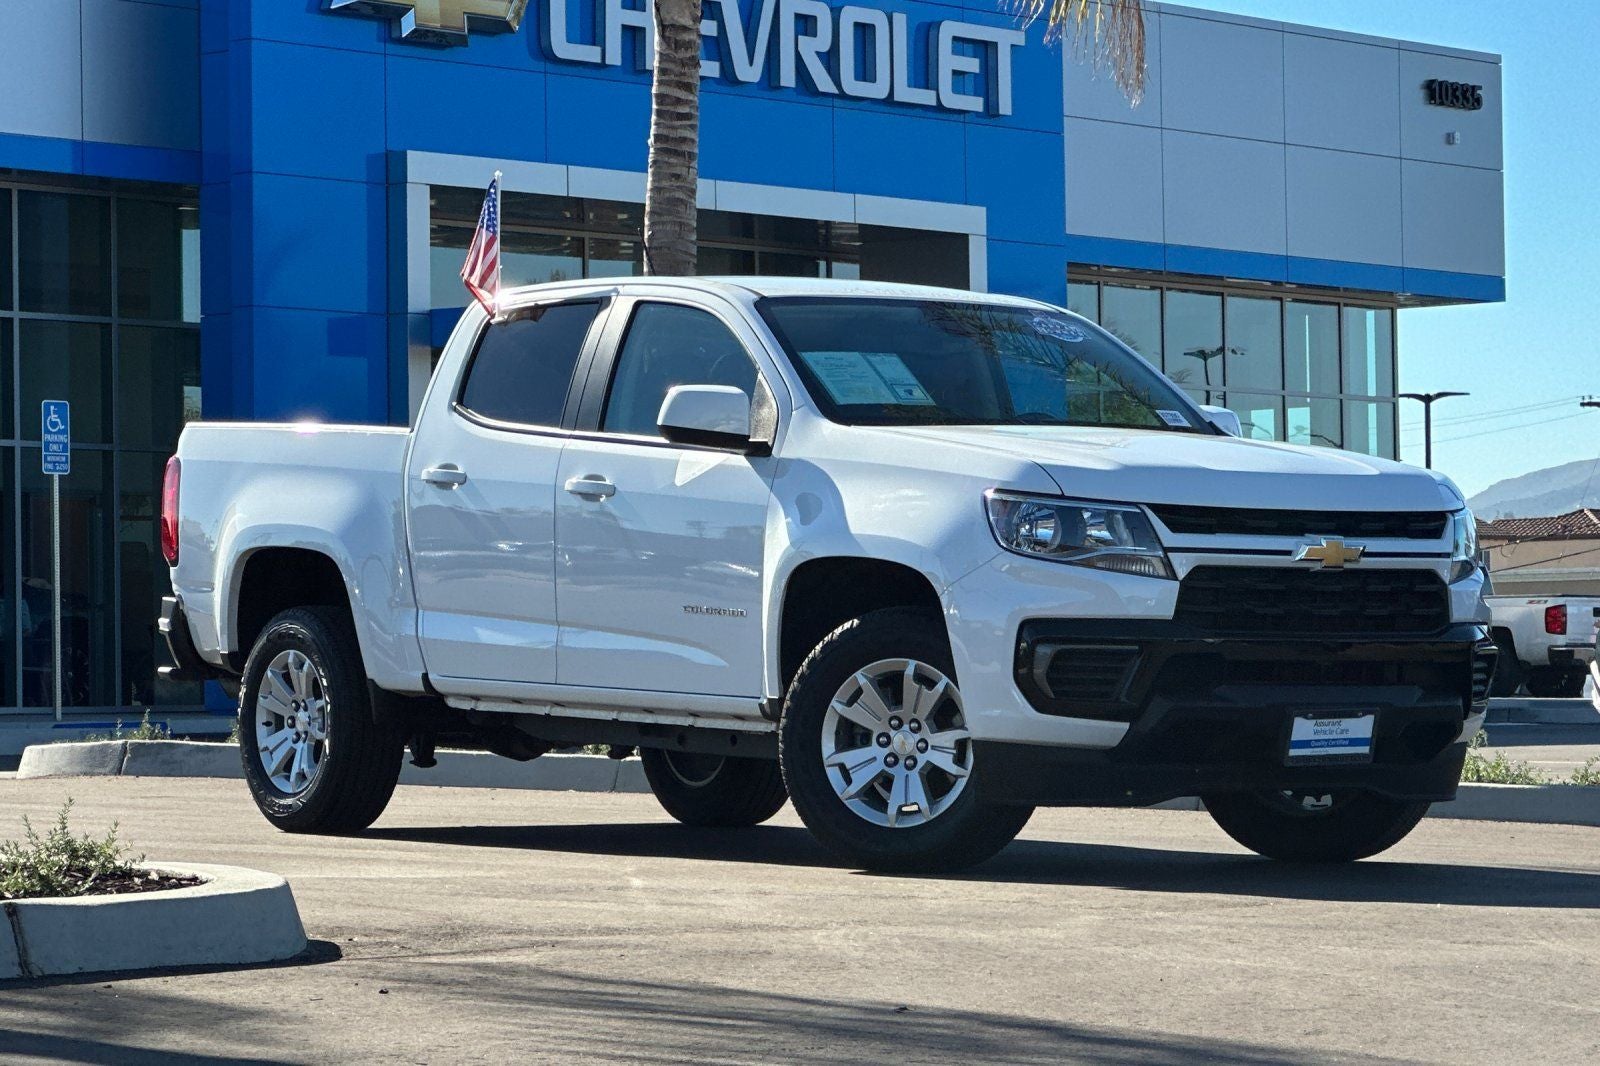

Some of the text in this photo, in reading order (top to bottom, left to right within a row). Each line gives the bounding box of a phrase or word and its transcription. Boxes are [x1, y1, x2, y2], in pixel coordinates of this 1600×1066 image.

[1427, 79, 1482, 110] 10335
[45, 434, 67, 443] PARKING
[49, 443, 63, 452] ONLY
[1314, 720, 1342, 728] Assurant
[1313, 727, 1350, 736] Vehicle Care
[1310, 740, 1328, 748] Quality
